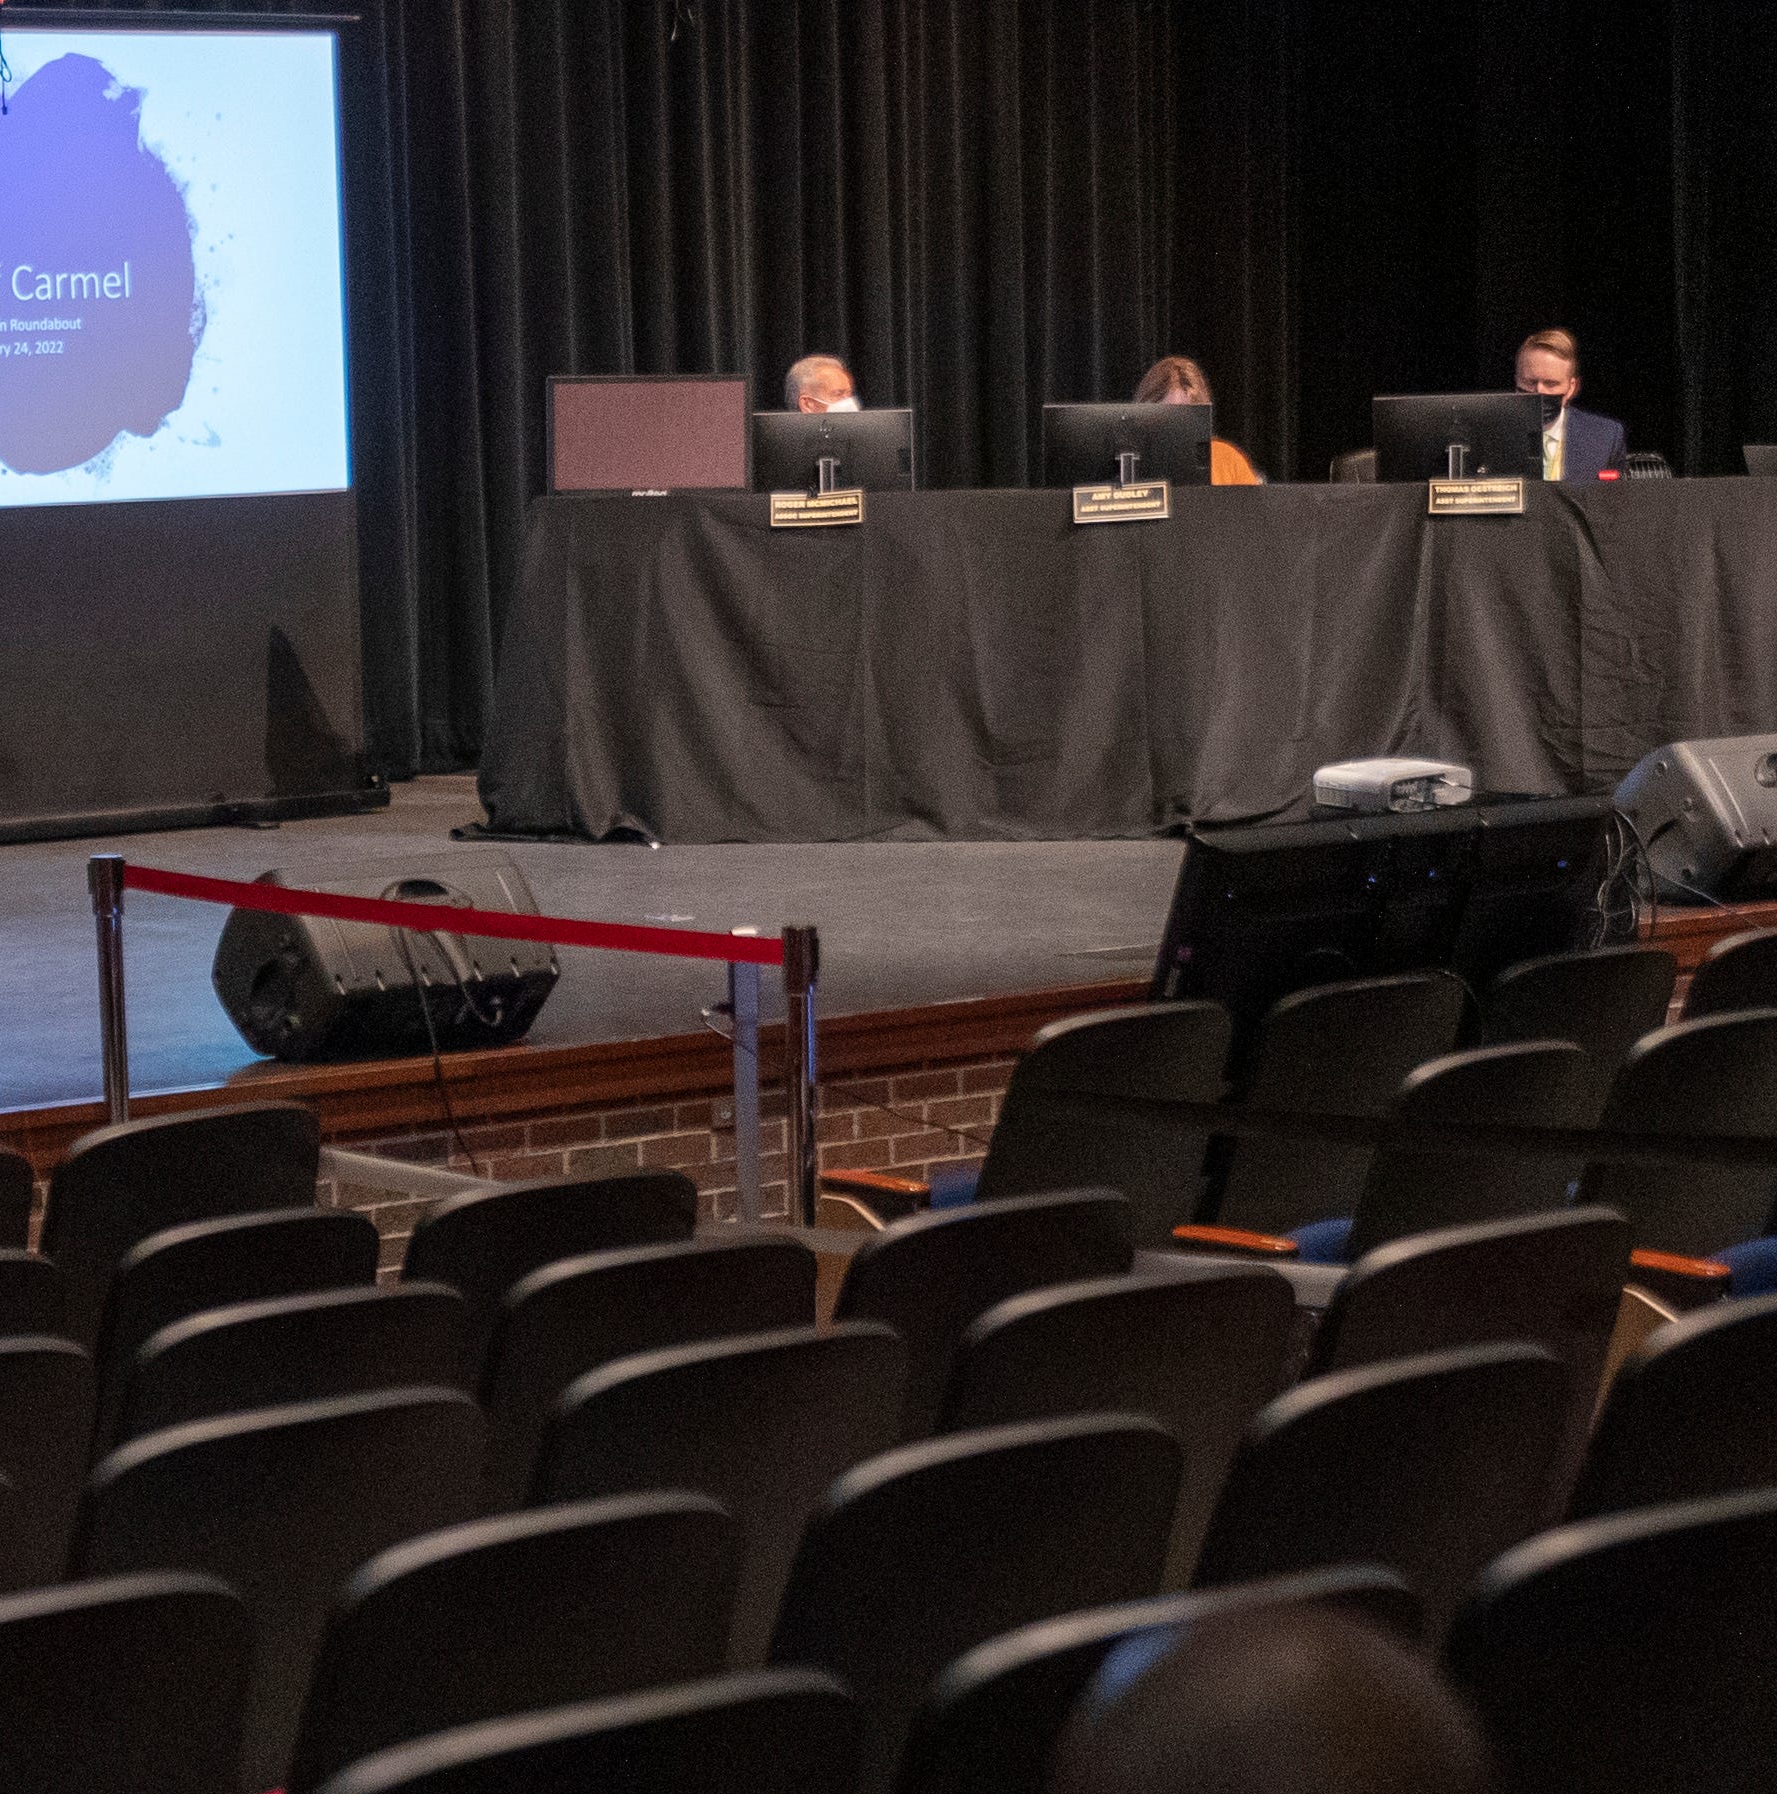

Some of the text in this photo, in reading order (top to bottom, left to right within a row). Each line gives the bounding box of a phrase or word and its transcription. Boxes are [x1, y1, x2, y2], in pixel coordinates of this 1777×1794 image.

[11, 261, 131, 301] Carmel
[9, 317, 82, 332] Roundabout
[13, 342, 32, 357] 24,
[35, 341, 64, 354] 2022
